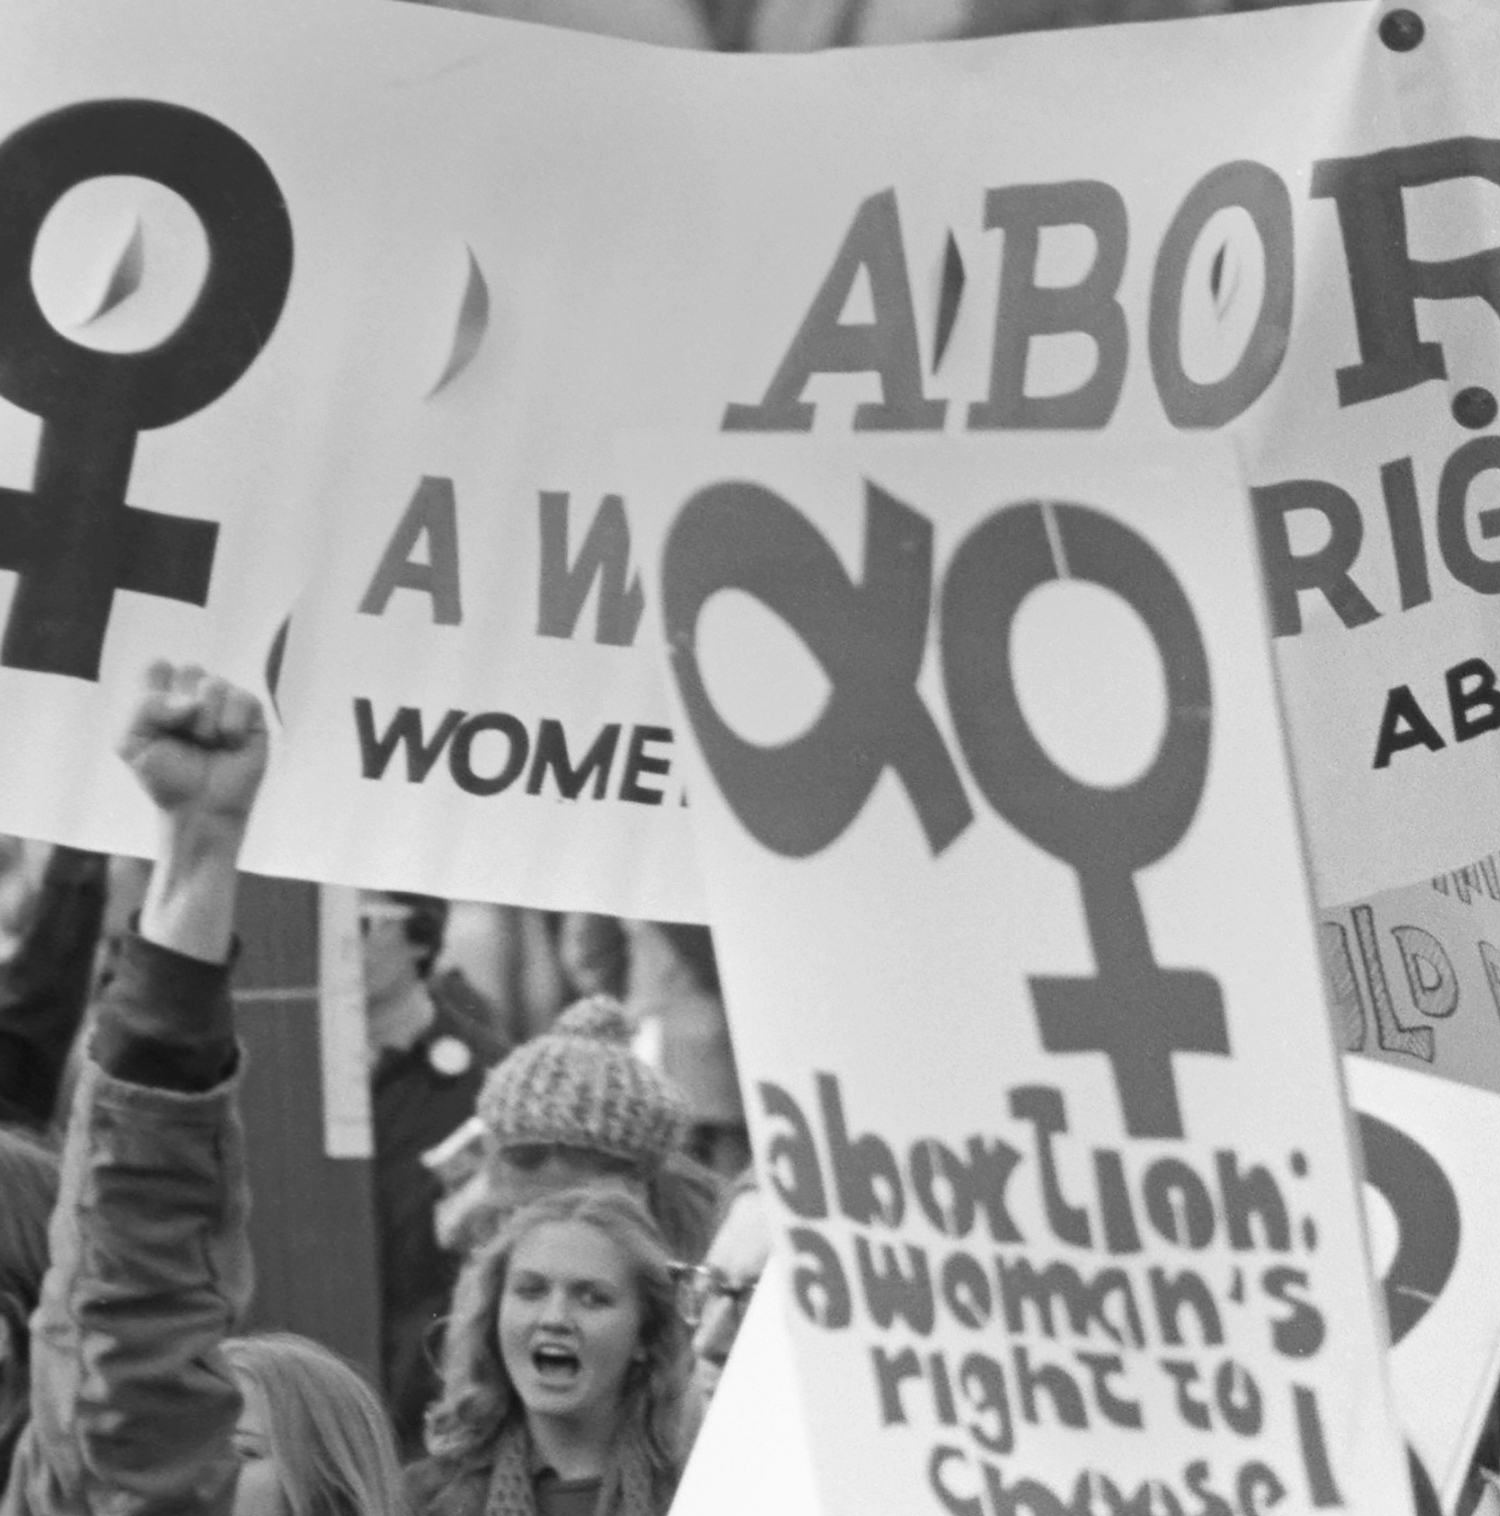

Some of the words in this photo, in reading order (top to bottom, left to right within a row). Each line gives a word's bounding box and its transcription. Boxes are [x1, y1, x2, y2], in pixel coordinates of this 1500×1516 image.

[358, 474, 463, 627] A
[353, 697, 690, 808] WOME
[870, 1344, 1146, 1456] right
[1159, 1357, 1264, 1438] to
